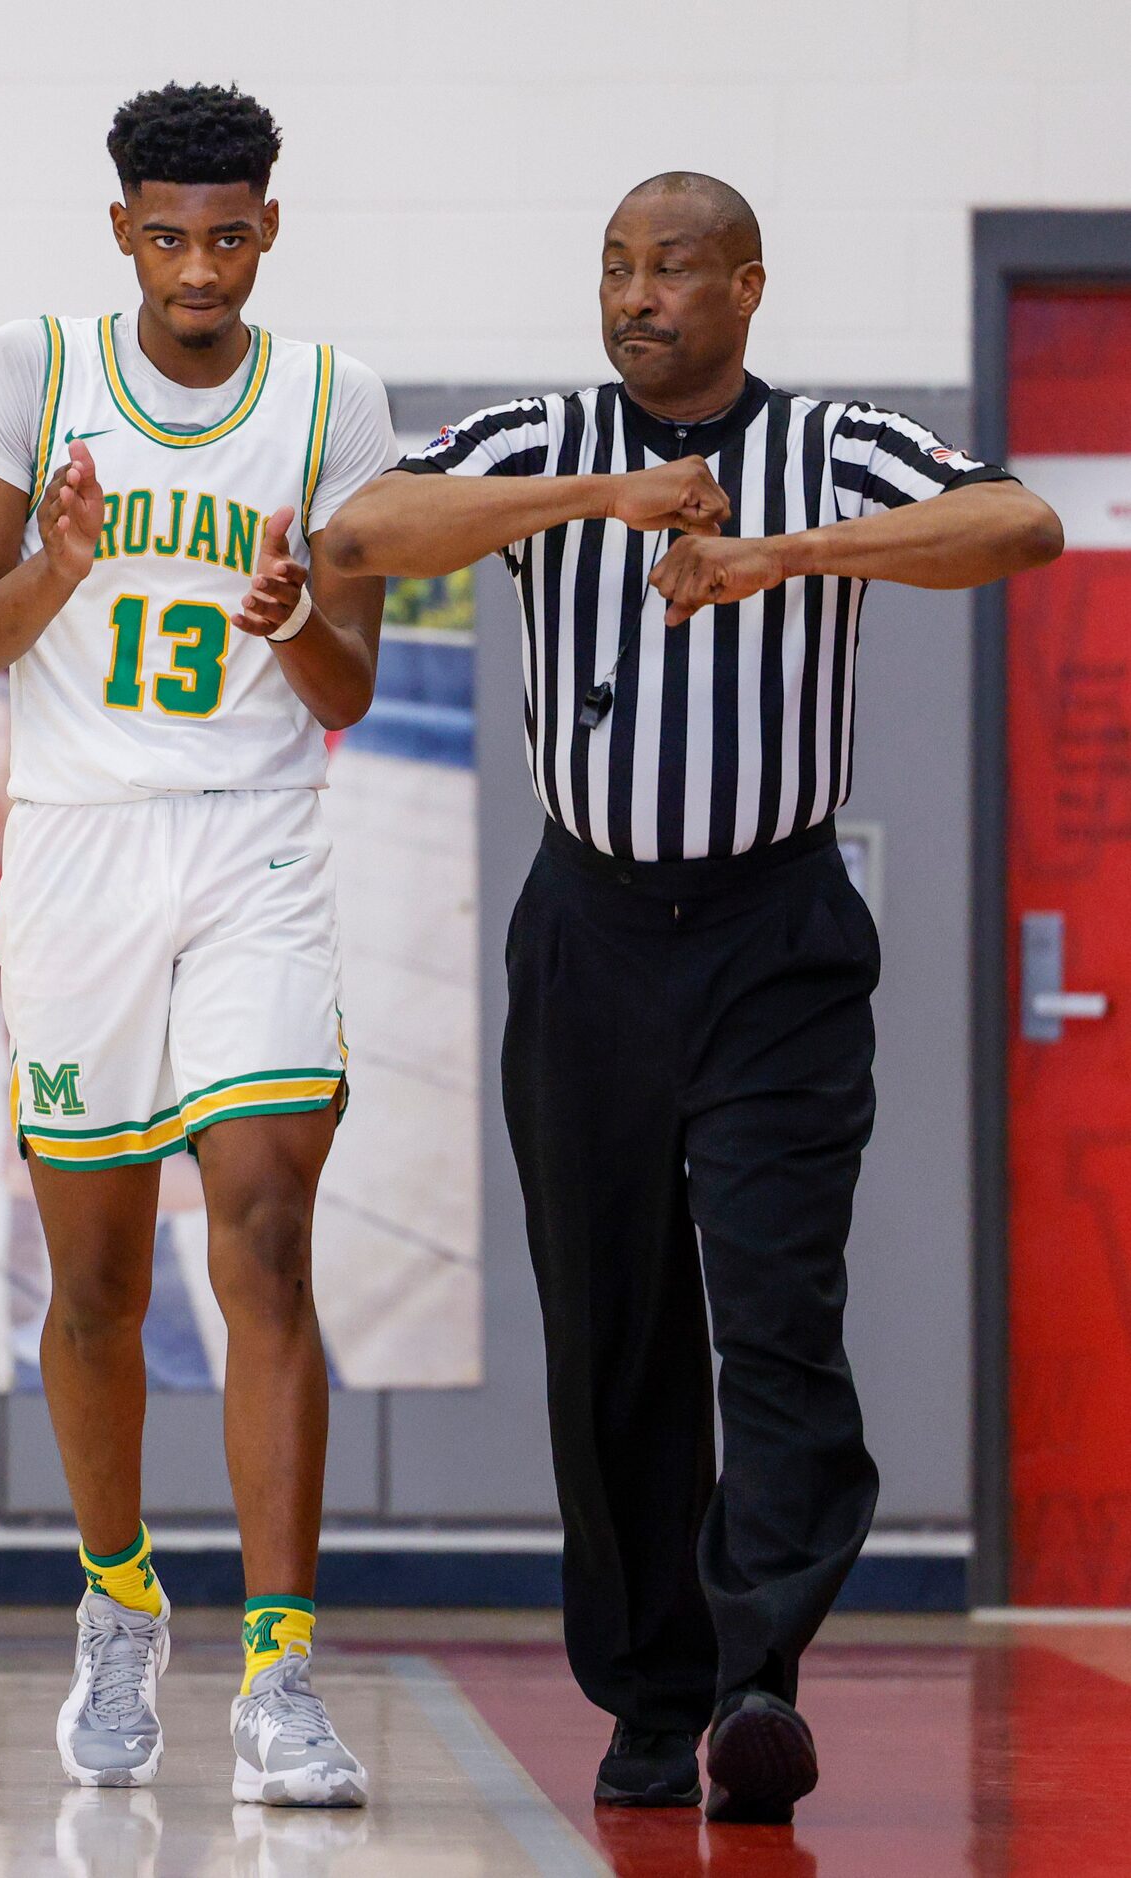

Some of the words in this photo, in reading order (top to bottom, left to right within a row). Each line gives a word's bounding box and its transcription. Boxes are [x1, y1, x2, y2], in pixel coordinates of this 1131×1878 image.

[94, 488, 270, 577] ROJAN
[102, 593, 230, 719] 13
[28, 1061, 86, 1116] M
